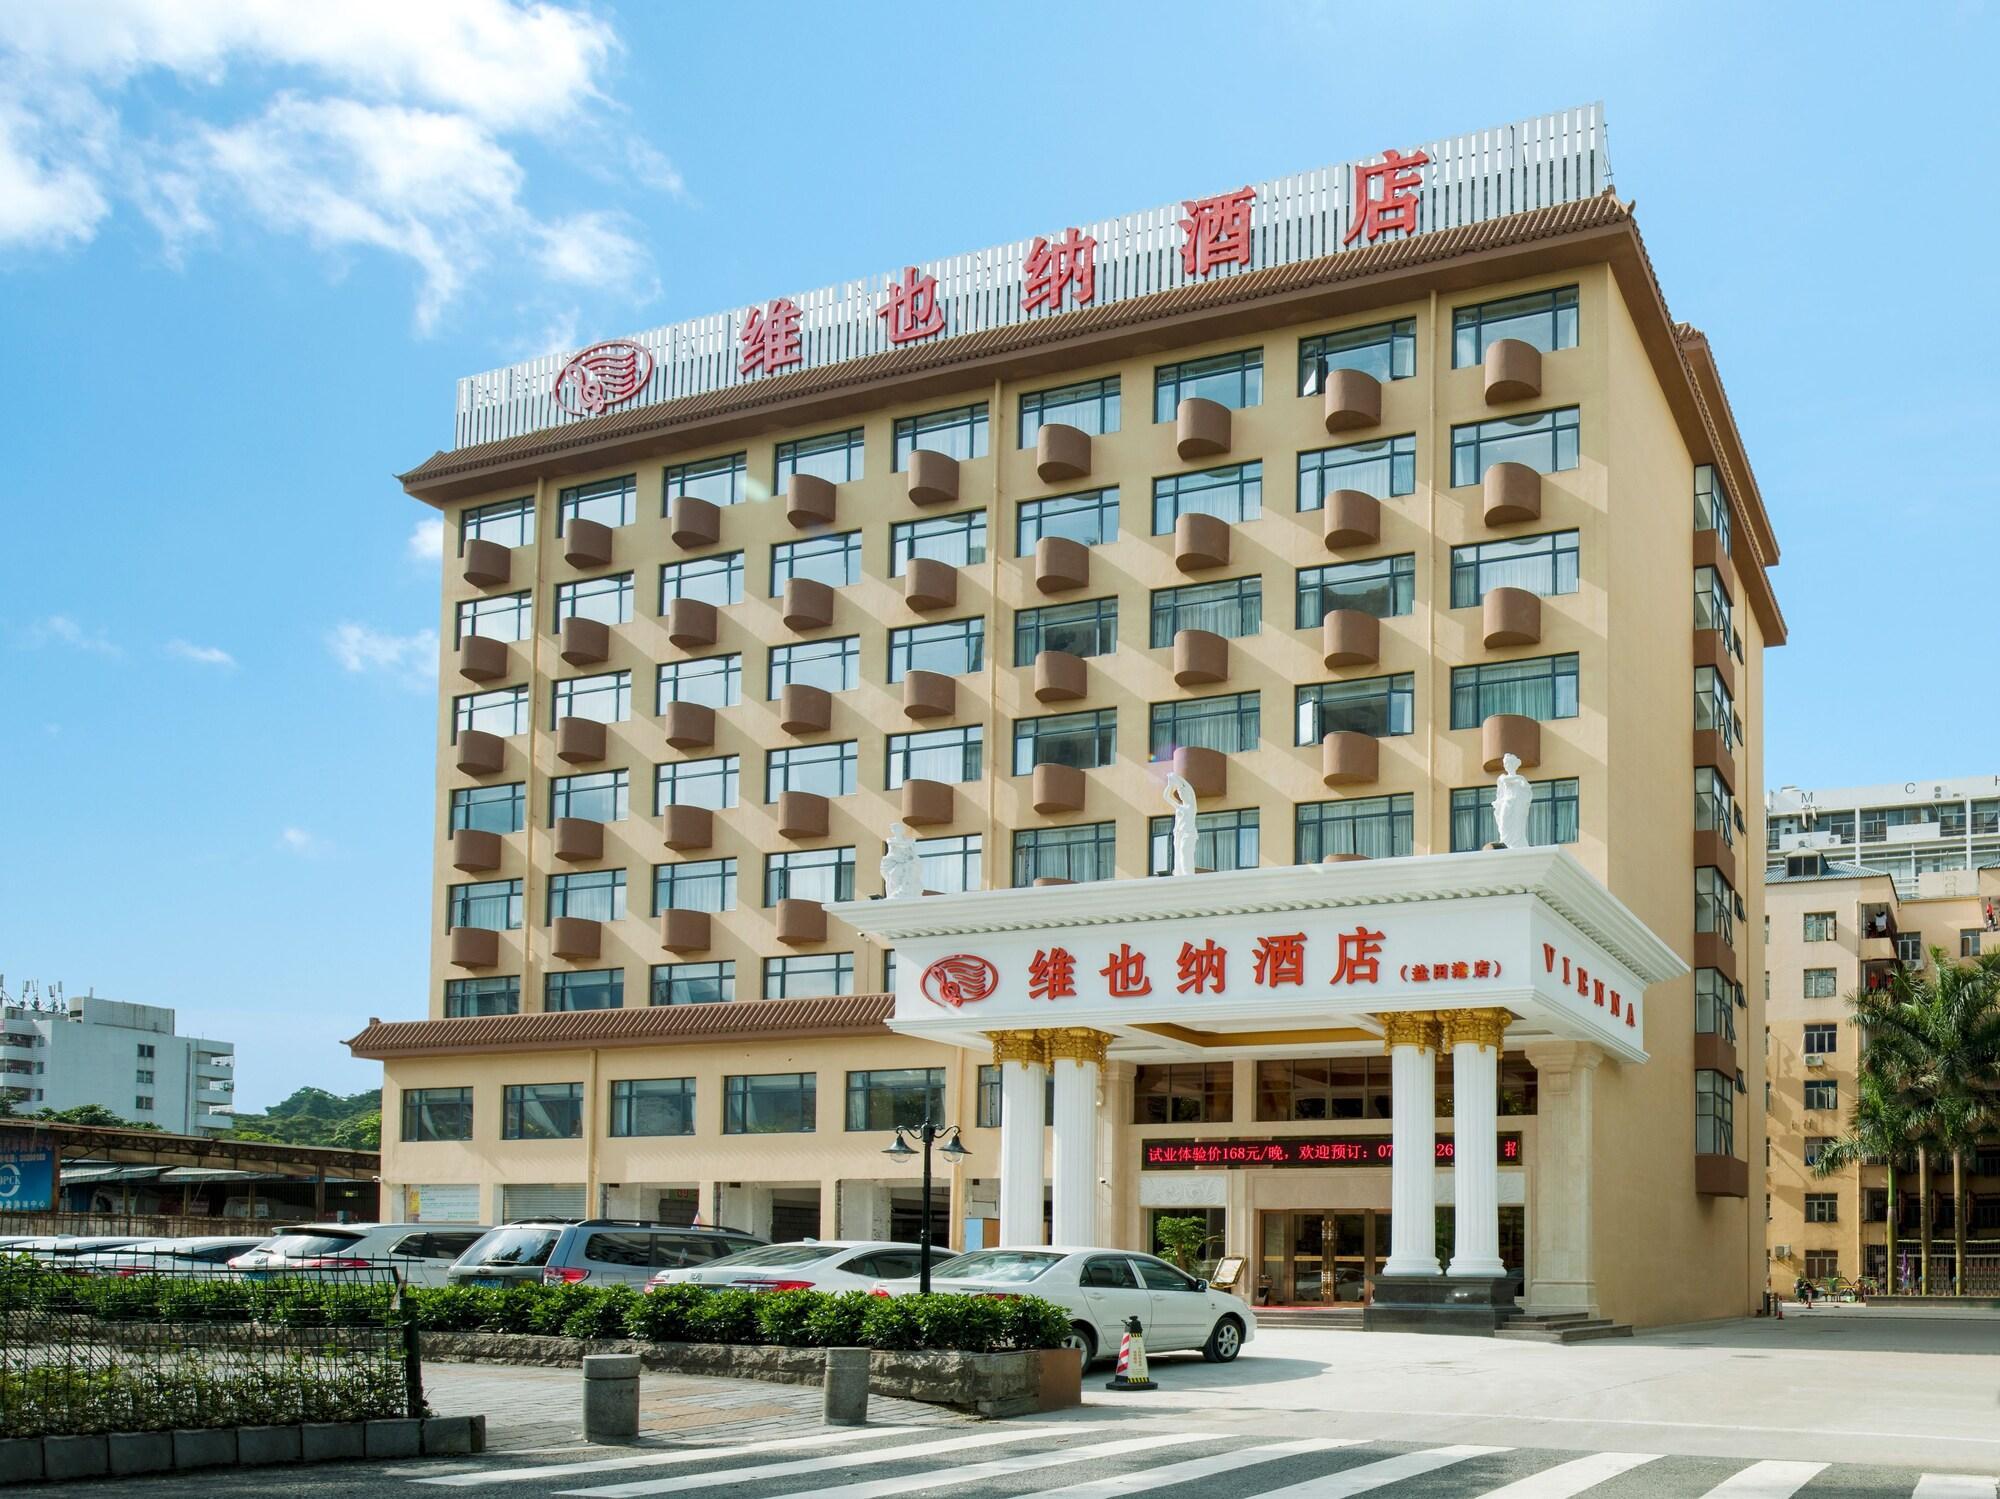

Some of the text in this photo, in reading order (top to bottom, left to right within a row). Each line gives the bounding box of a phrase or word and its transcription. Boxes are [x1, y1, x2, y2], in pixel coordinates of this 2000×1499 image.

[739, 149, 1430, 375] 维也纳酒店
[1028, 926, 1386, 1001] 维也纳酒店
[1542, 943, 1636, 1027] VIENNA
